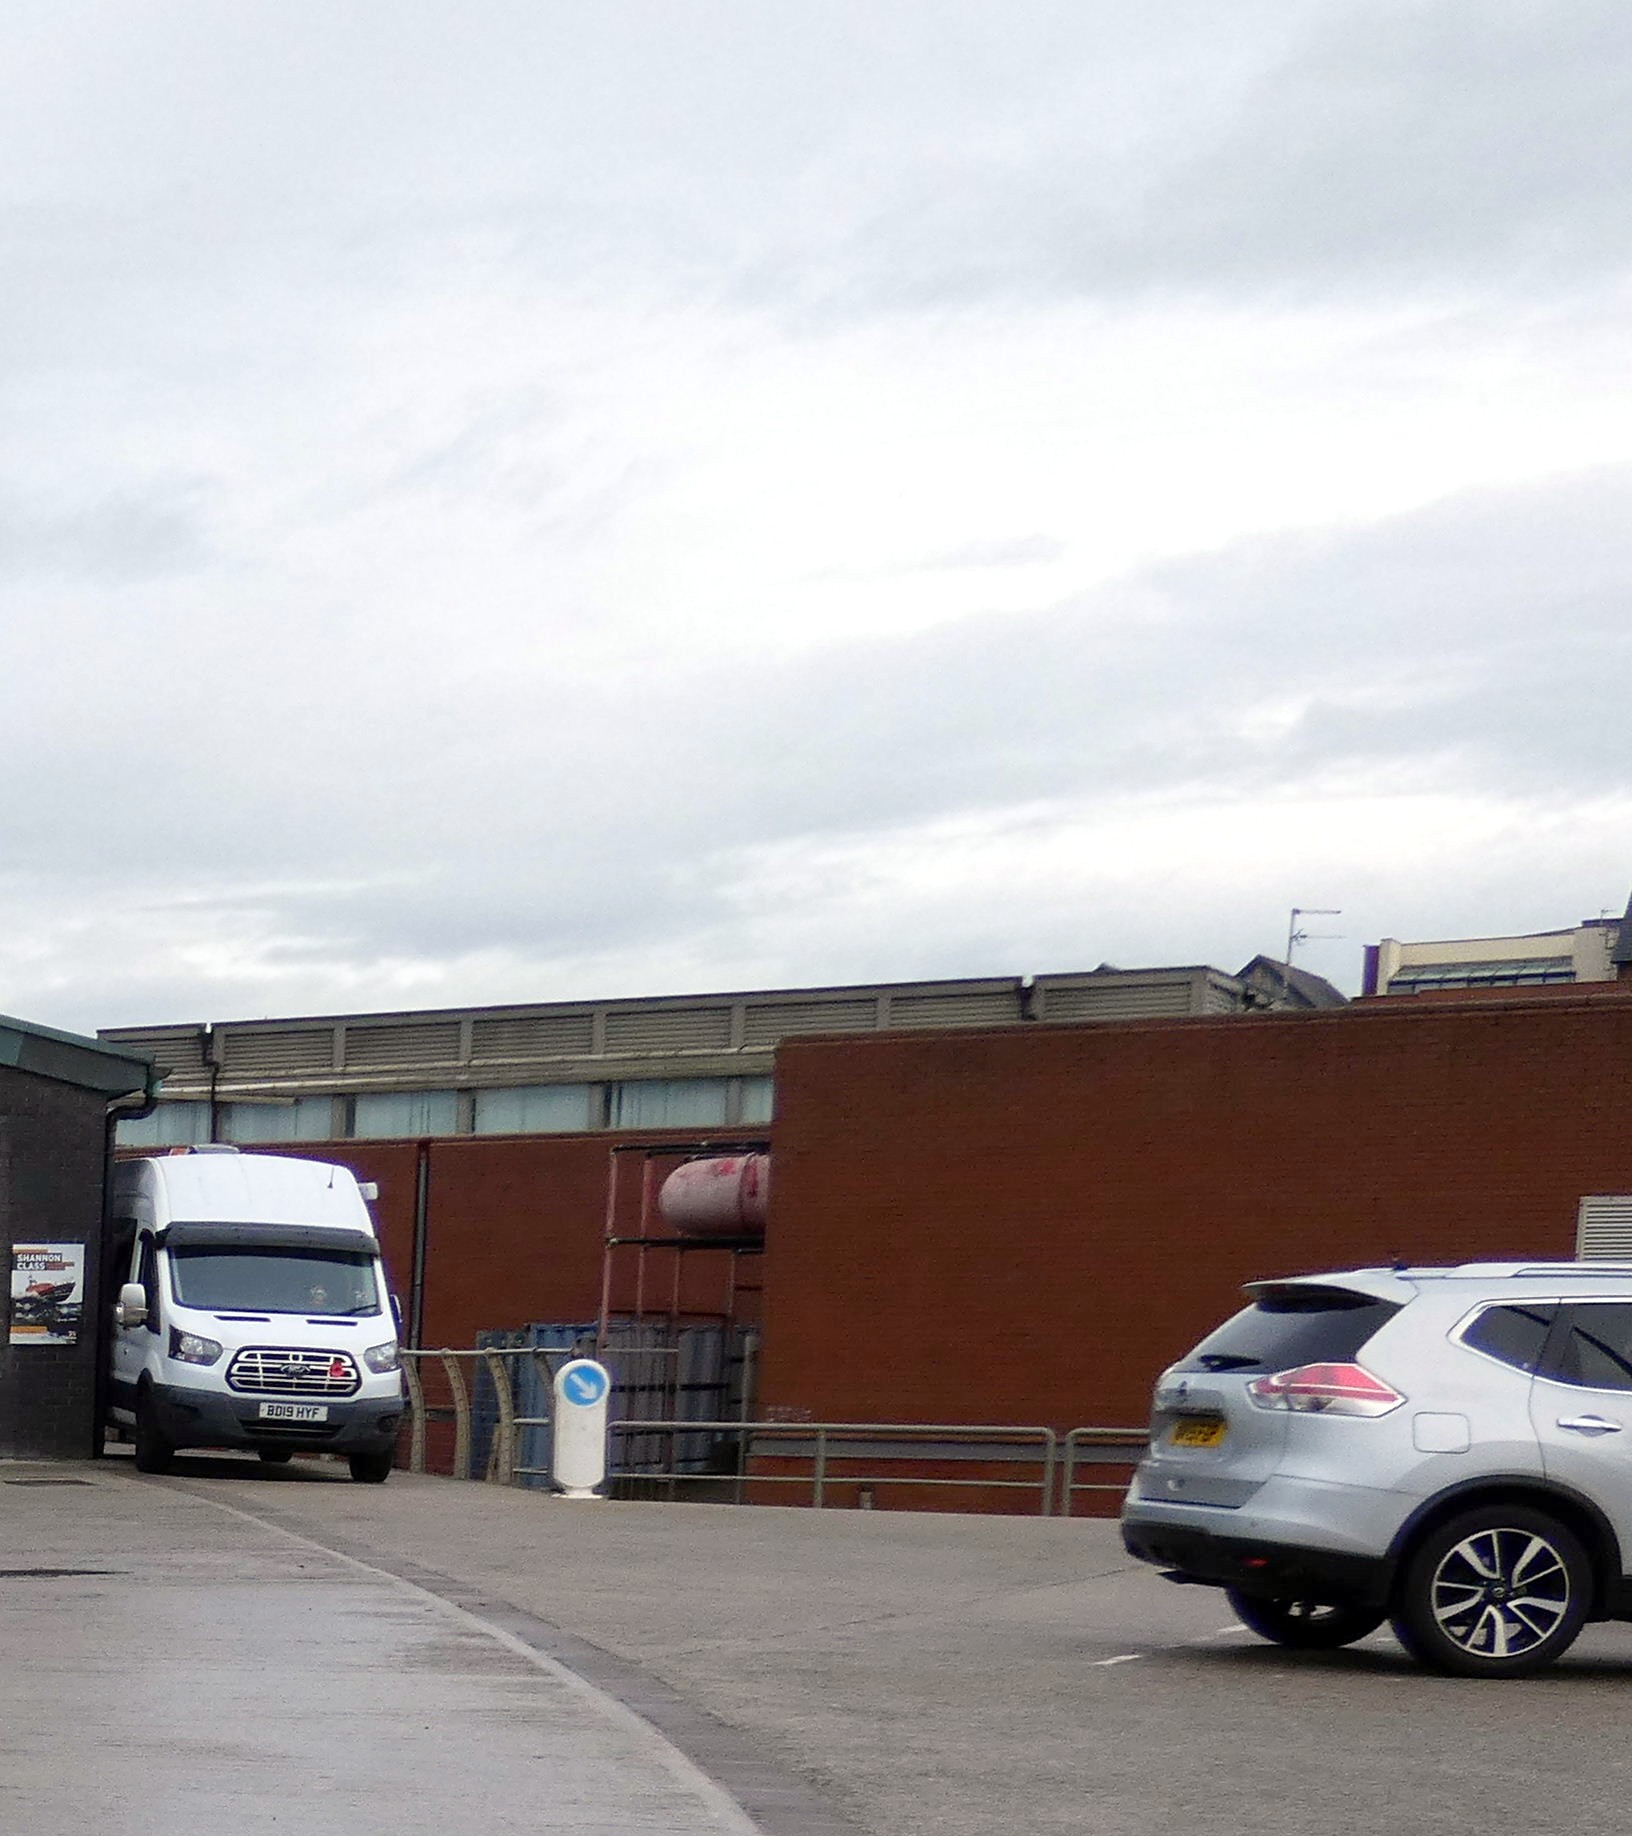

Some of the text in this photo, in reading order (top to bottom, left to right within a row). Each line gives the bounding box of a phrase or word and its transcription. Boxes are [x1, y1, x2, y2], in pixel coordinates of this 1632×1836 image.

[17, 1254, 62, 1262] SHANNON
[17, 1262, 46, 1270] CLASS
[267, 1405, 320, 1418] BD19 HYF
